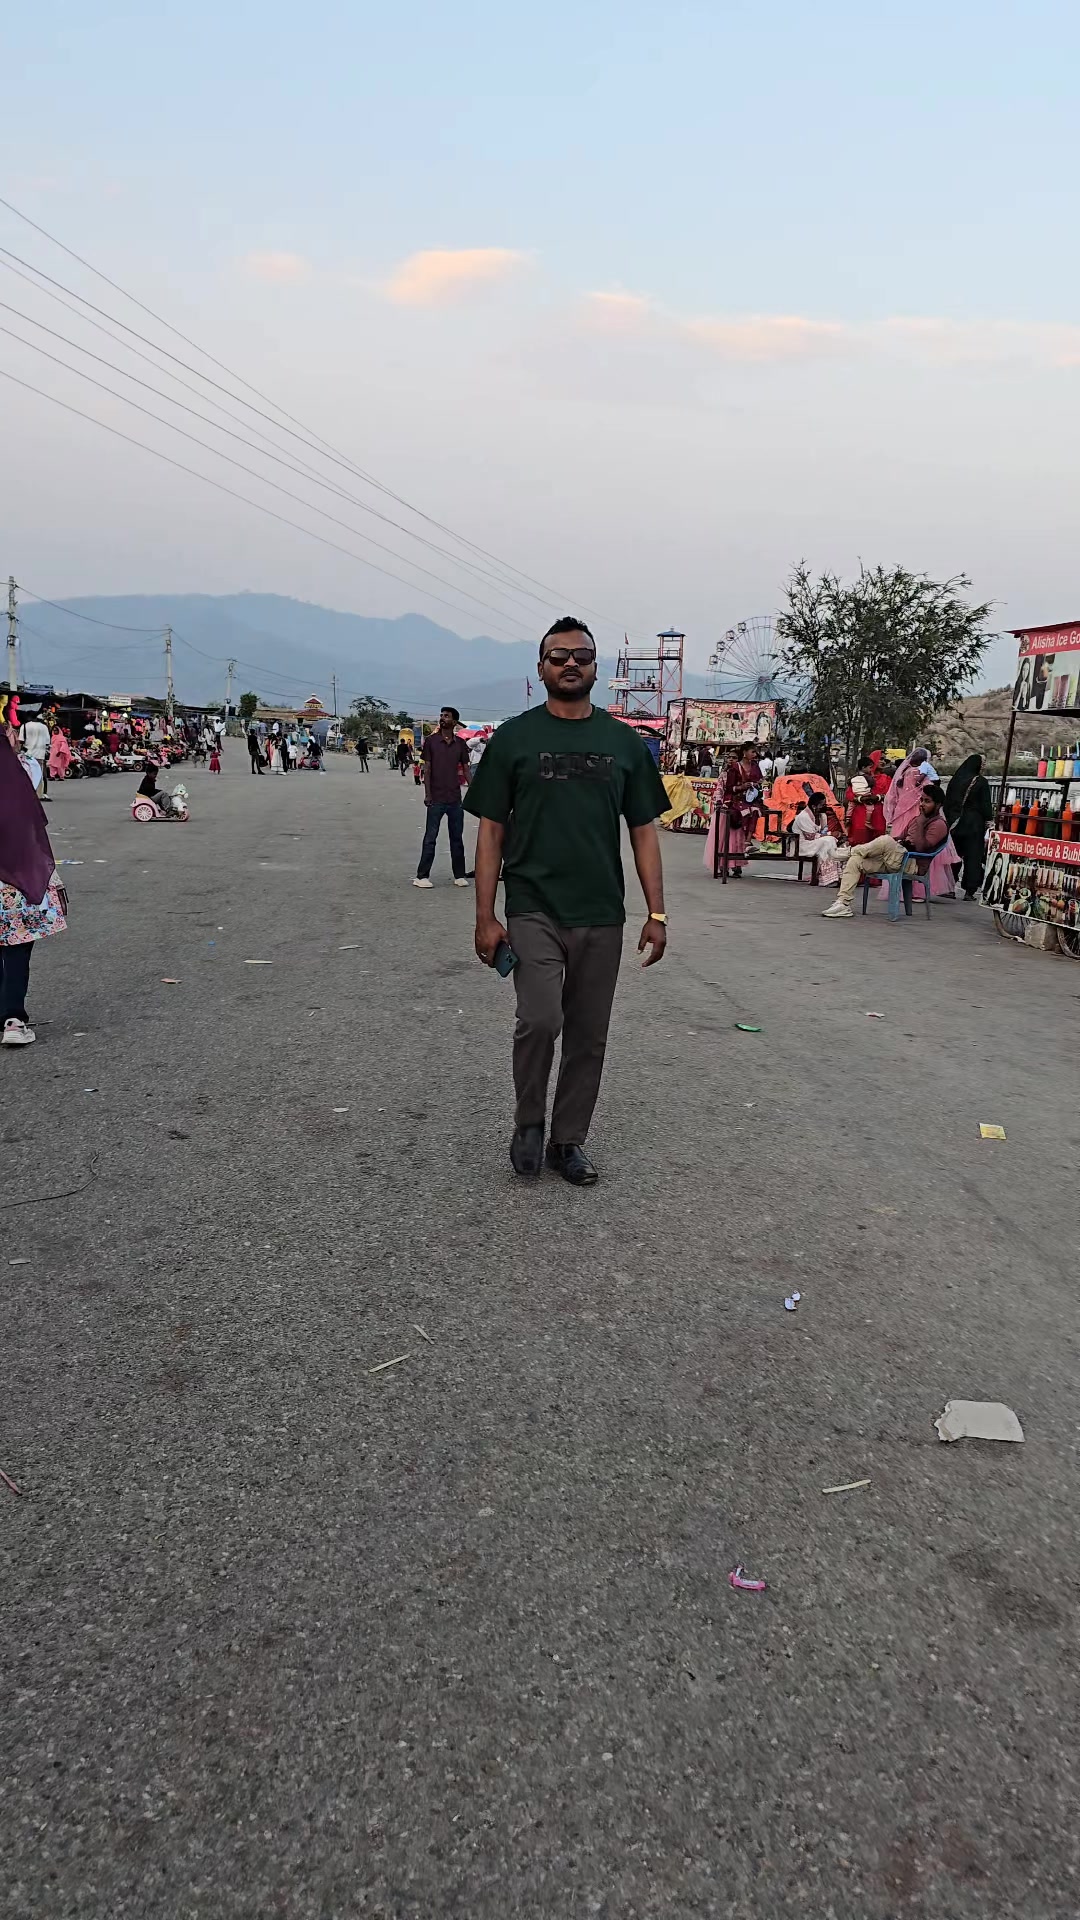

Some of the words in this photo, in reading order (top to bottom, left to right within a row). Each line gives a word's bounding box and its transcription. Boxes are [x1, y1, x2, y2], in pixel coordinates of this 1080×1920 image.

[1031, 634, 1055, 649] Alisha
[1056, 633, 1067, 647] Ice
[1001, 838, 1023, 853] Alisha
[1023, 840, 1035, 854] Ice
[1035, 842, 1054, 857] Gola
[1054, 844, 1061, 860] &
